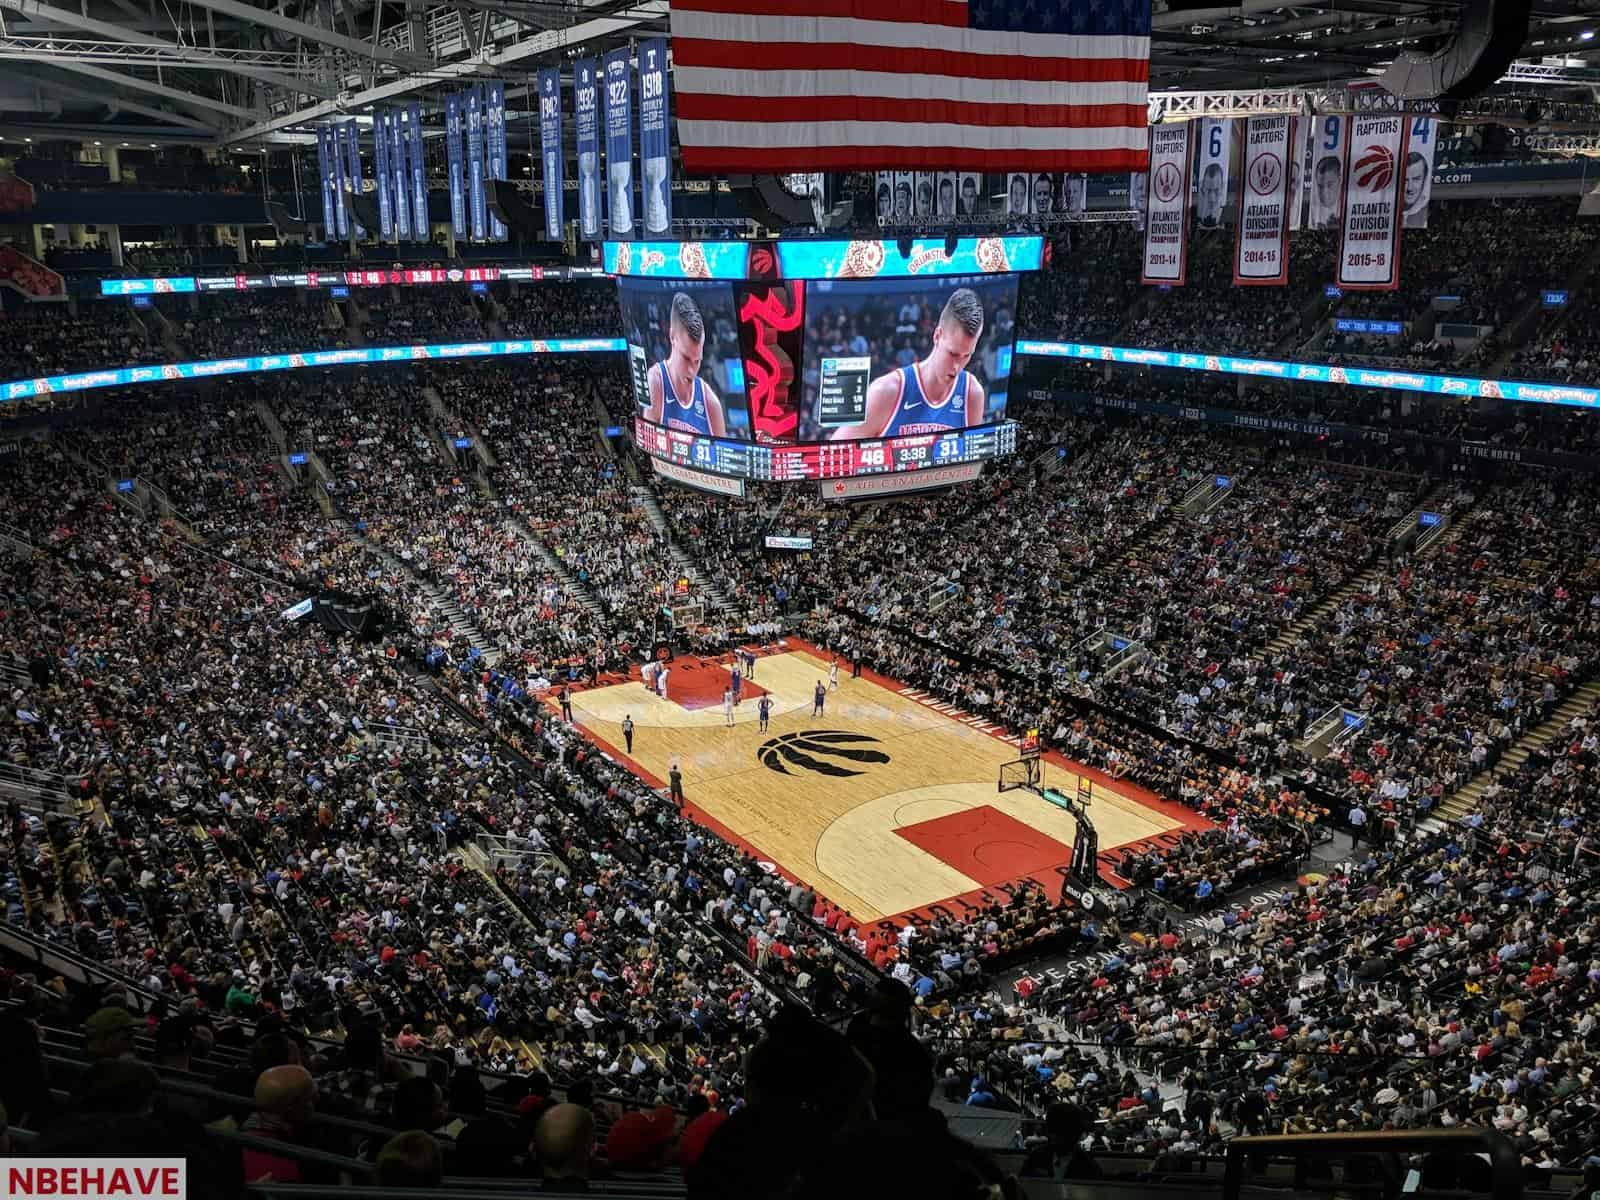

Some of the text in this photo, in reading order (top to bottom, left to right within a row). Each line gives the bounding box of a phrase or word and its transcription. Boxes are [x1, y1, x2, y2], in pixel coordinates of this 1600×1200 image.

[1251, 117, 1285, 131] TORONTO
[1356, 119, 1398, 137] RAPTORS
[1412, 116, 1430, 144] 4
[1155, 129, 1185, 142] TORONTO
[1250, 130, 1284, 145] RAPTORS
[1323, 115, 1340, 150] 9
[1155, 142, 1184, 154] RAPTORS
[1209, 126, 1222, 158] 6
[1246, 203, 1280, 217] ATLANTIC
[1351, 201, 1391, 215] ATLANTIC
[1151, 211, 1180, 222] ATLANTIC
[1245, 217, 1279, 230] DIVISION
[1350, 216, 1389, 230] DIVISION
[1151, 223, 1179, 234] DIVISION
[1244, 250, 1276, 263] 2014-15
[1271, 420, 1298, 432] MAPLE
[880, 474, 929, 489] CANADA
